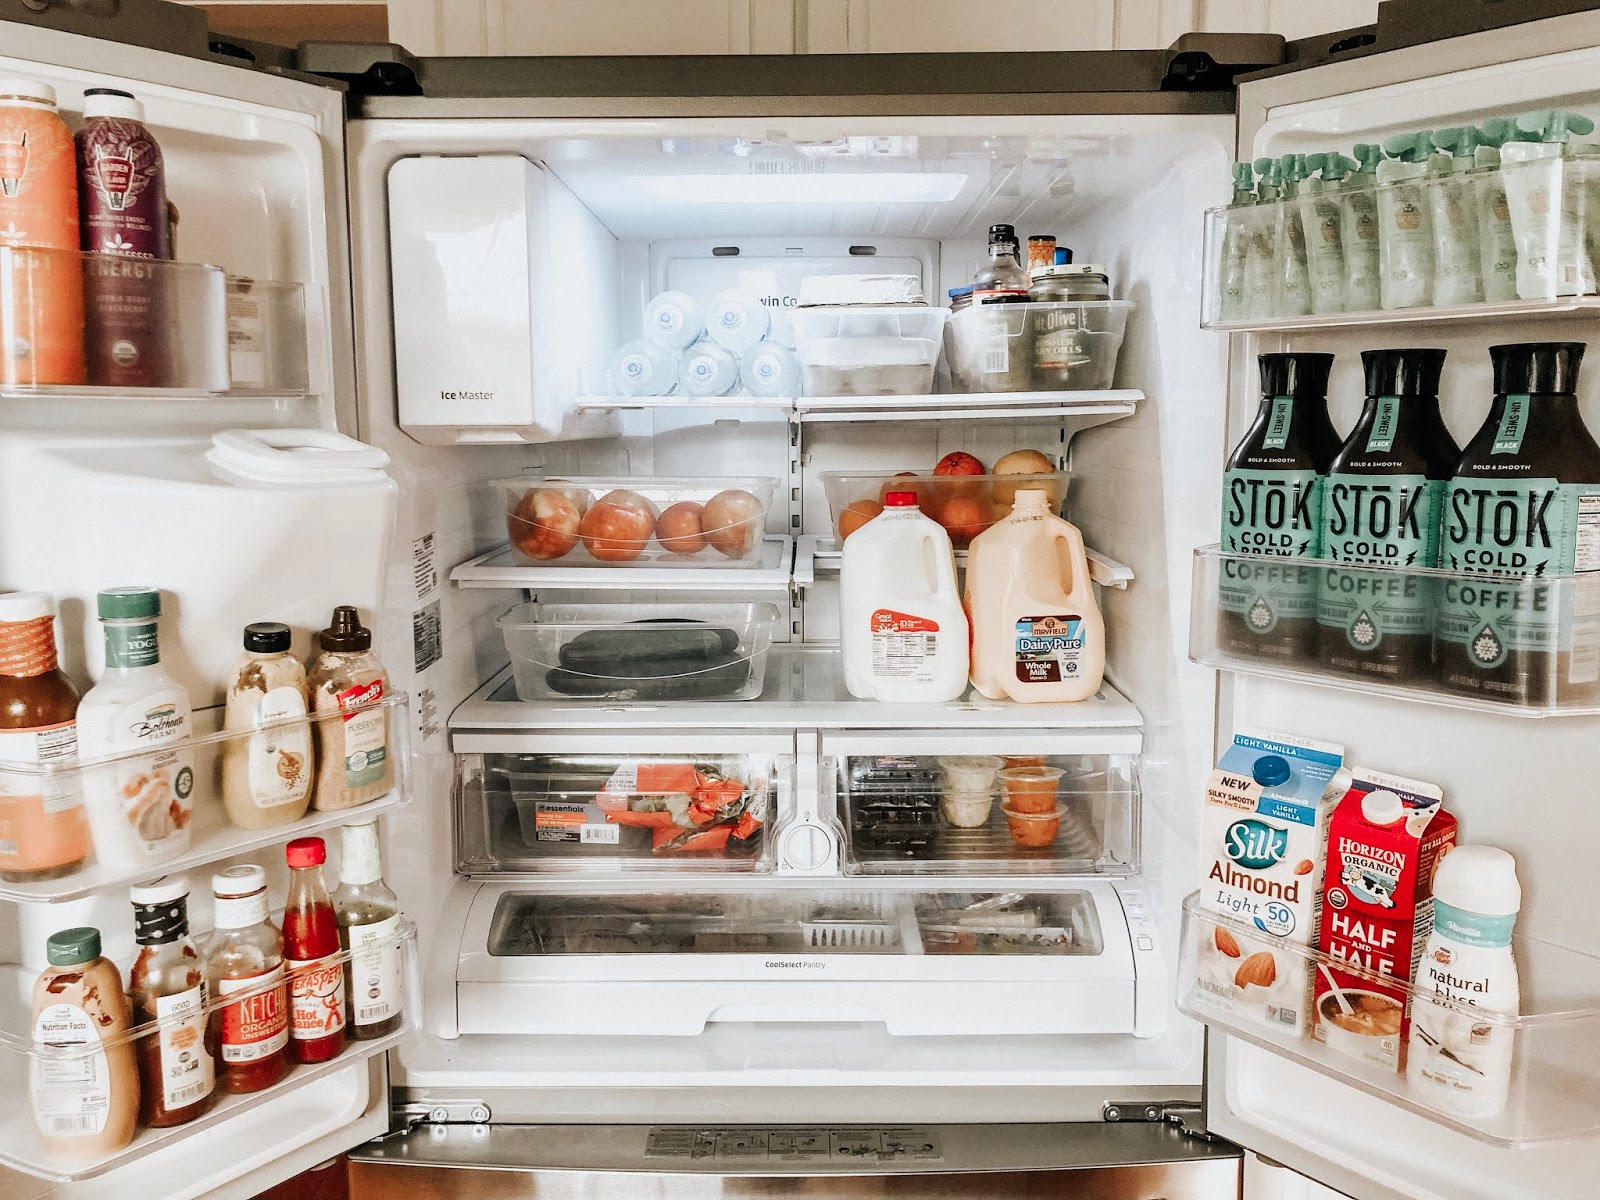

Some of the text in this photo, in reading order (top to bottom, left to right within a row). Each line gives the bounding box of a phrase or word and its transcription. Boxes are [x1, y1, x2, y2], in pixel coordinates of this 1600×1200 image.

[1047, 310, 1077, 330] Olive
[1053, 345, 1083, 354] DILLS
[441, 390, 495, 400] Ice Master
[1241, 531, 1293, 547] COLD
[1343, 541, 1399, 557] COLD
[1464, 549, 1527, 568] COLD
[1225, 559, 1309, 584] COFFEE
[1326, 568, 1418, 597] COFFEE
[875, 612, 892, 620] Great
[127, 639, 158, 649] YOGU
[1025, 661, 1052, 670] Whole
[1030, 668, 1048, 676] Milk
[38, 728, 69, 736] Nutrition
[130, 714, 184, 738] Bolthouse
[149, 728, 177, 741] FARMS
[1235, 736, 1297, 756] LIGHT VANILLA
[1220, 776, 1251, 791] NEW
[1208, 789, 1256, 806] SILKY SMOOTH
[1210, 796, 1223, 805] Taste
[1238, 803, 1251, 811] Love
[1269, 792, 1310, 806] Almondmilk
[546, 804, 585, 813] essentials
[1271, 809, 1301, 821] VANILLA
[1276, 803, 1298, 814] LIGHT
[1224, 823, 1283, 861] Silk
[1432, 838, 1441, 848] ALL
[1338, 836, 1407, 870] HORIZON
[1344, 855, 1398, 877] ORGANIC
[1208, 859, 1300, 904] Almond
[1216, 890, 1260, 914] Light
[1267, 905, 1290, 923] 50
[1331, 911, 1397, 949] HALF
[1447, 920, 1481, 936] Vanilla
[1351, 941, 1372, 952] AND
[803, 961, 826, 969] Pantry
[293, 972, 319, 991] EXAS
[1429, 967, 1489, 993] natural
[171, 1000, 191, 1012] GOOD
[241, 984, 286, 1025] KETCHU
[296, 1009, 317, 1019] Hot
[42, 1022, 87, 1031] Nutrition Facts
